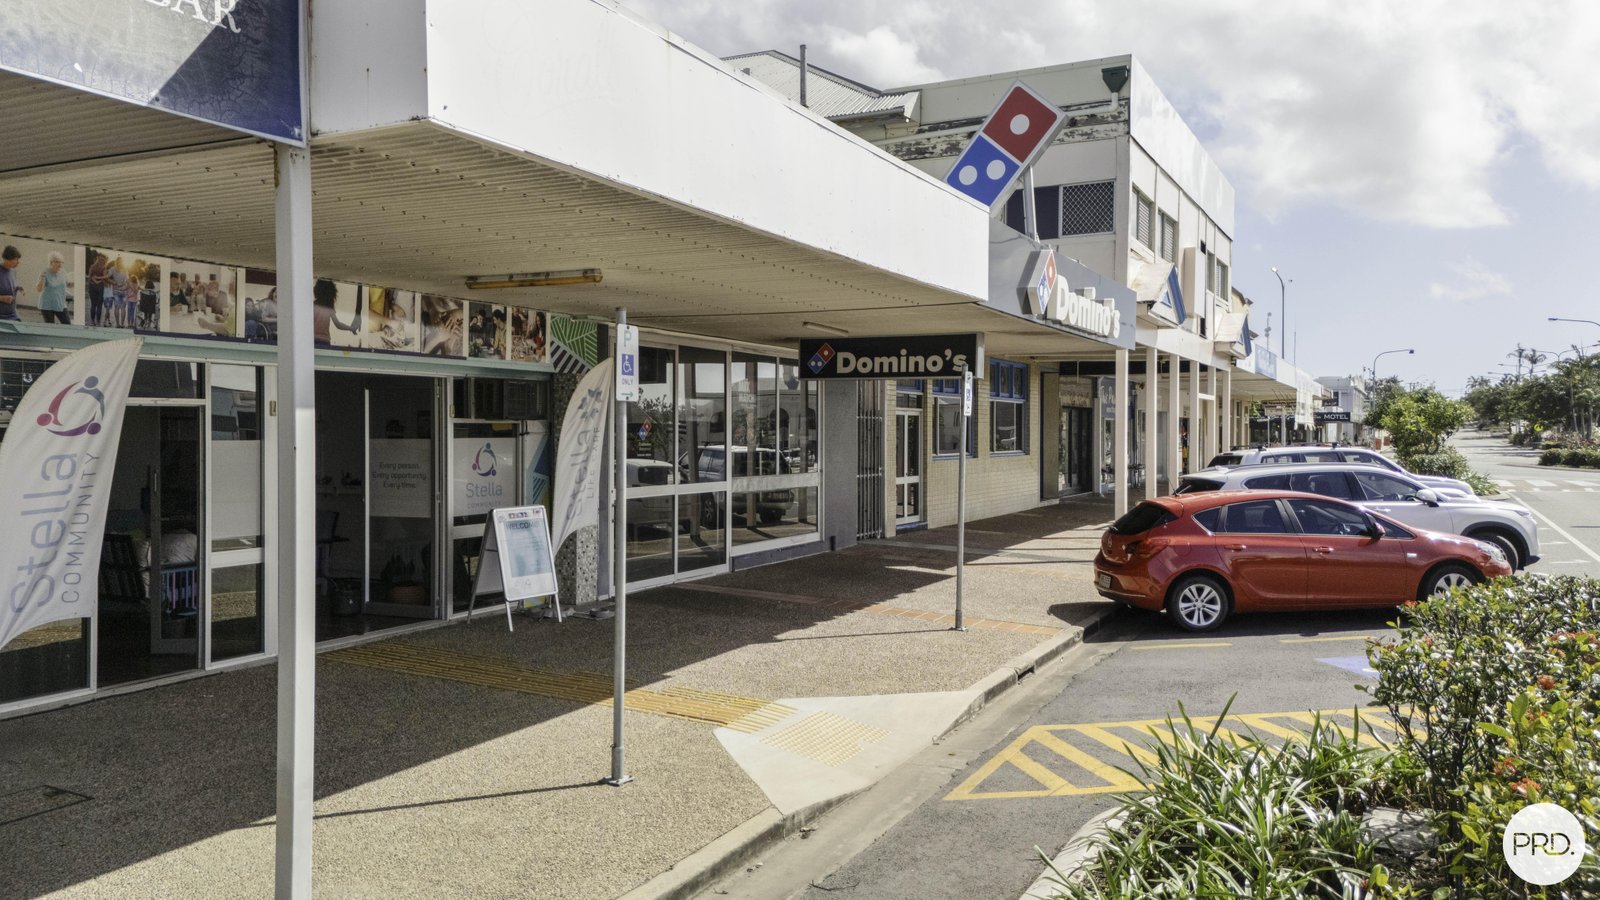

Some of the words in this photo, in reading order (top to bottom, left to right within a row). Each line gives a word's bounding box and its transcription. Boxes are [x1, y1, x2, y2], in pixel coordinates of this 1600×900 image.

[145, 0, 241, 33] AR
[1052, 274, 1121, 338] Domino's
[623, 329, 632, 347] P
[836, 347, 967, 374] Domino's
[621, 377, 633, 386] ONLY
[465, 482, 503, 498] Stella
[566, 429, 592, 521] Stella
[9, 452, 78, 615] Stella
[61, 451, 101, 604] COMMUNITY
